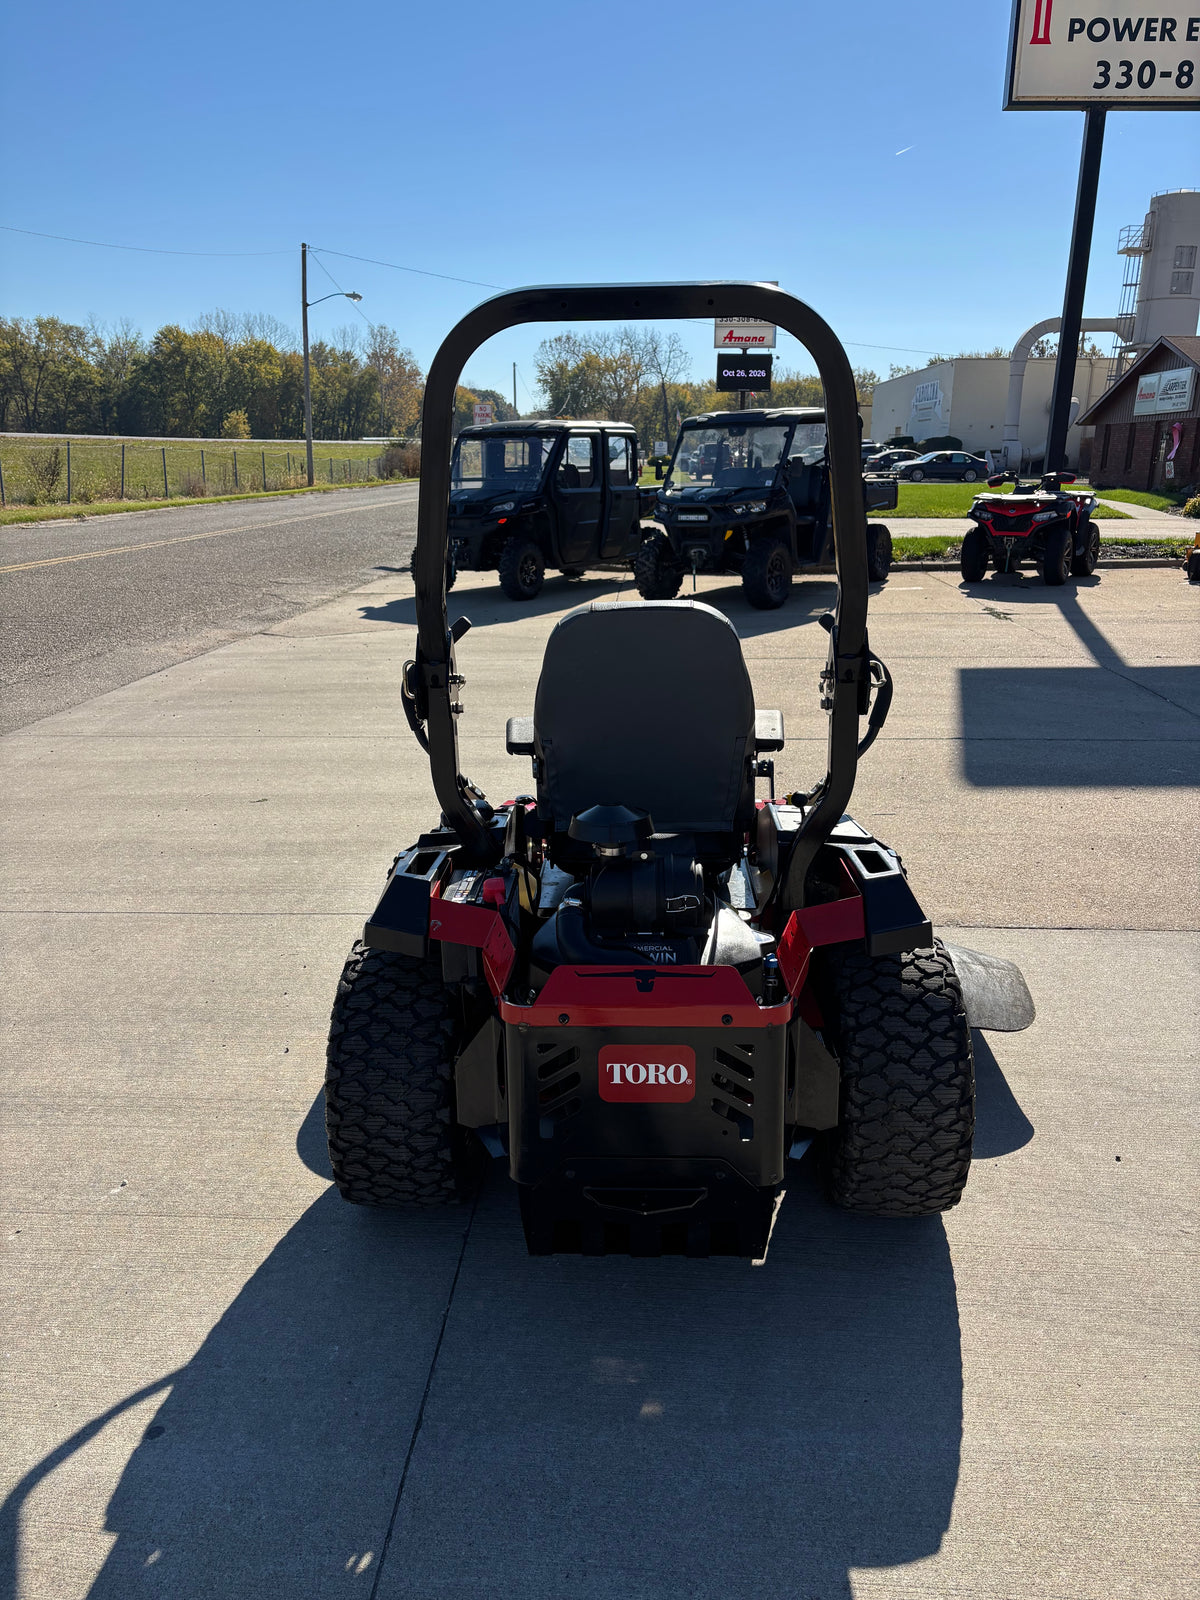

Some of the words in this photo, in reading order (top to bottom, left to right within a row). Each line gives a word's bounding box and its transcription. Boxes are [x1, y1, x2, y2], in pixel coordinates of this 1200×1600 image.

[1067, 17, 1177, 42] POWER
[1186, 17, 1200, 42] E
[1092, 60, 1195, 90] 330-8
[723, 330, 765, 342] Amana
[606, 1063, 688, 1085] TORO
